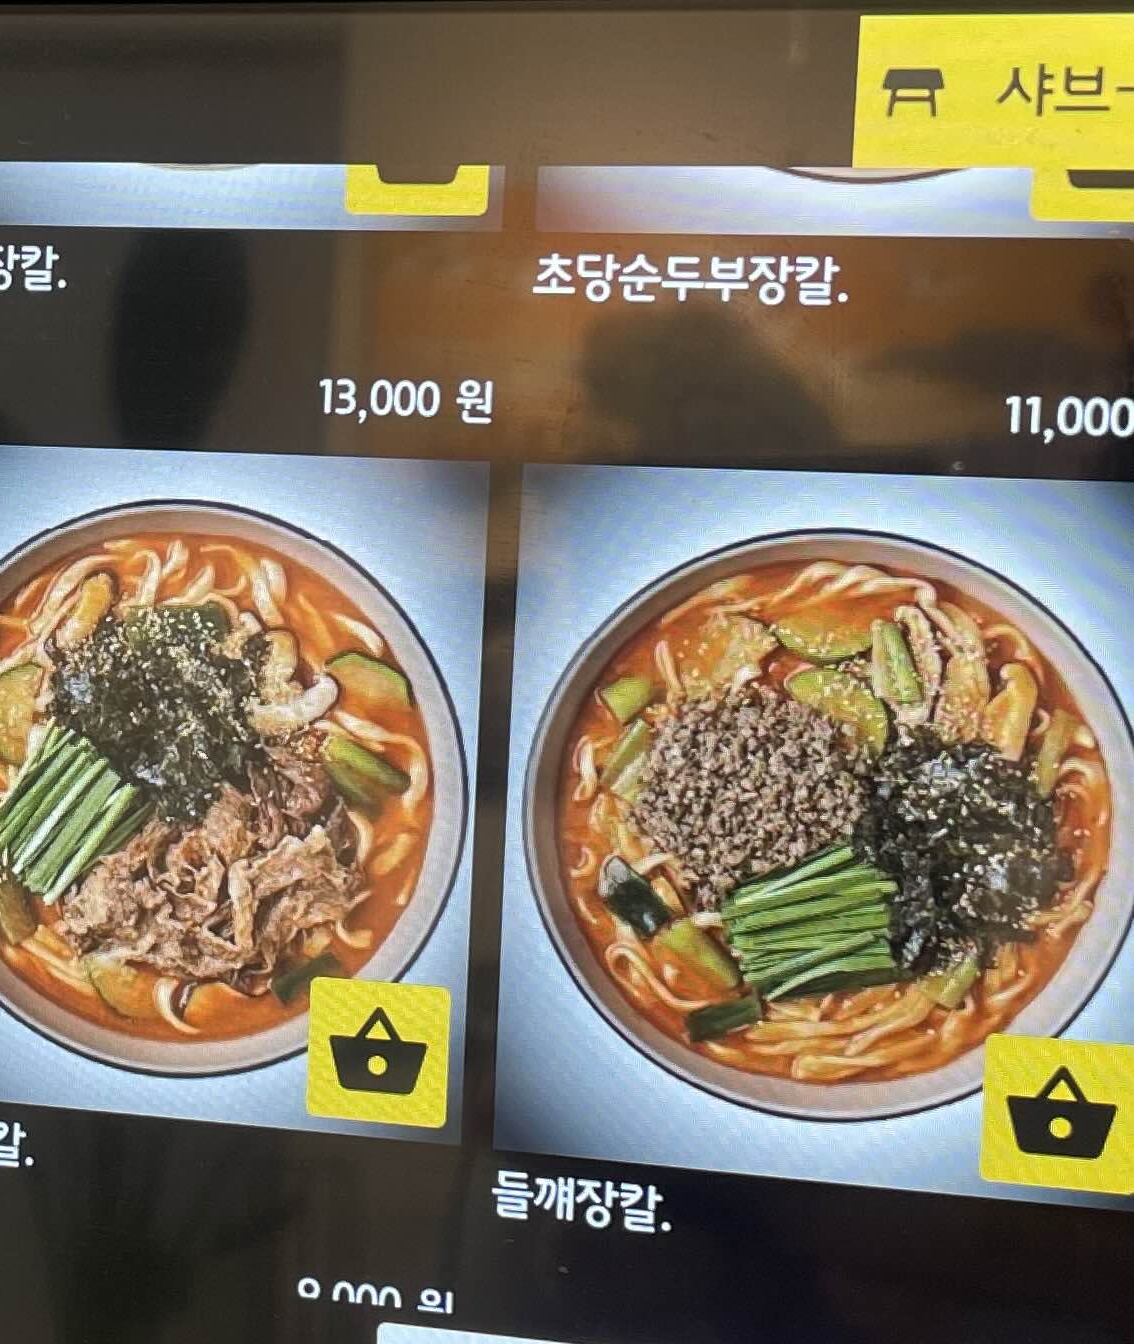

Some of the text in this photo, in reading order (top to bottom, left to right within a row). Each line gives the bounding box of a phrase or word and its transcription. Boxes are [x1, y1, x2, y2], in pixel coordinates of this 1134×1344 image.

[996, 63, 1134, 117] 샤브
[532, 251, 850, 306] 초당순두부장칼.
[318, 376, 495, 426] 13,000 원
[1004, 394, 1134, 445] 11,000
